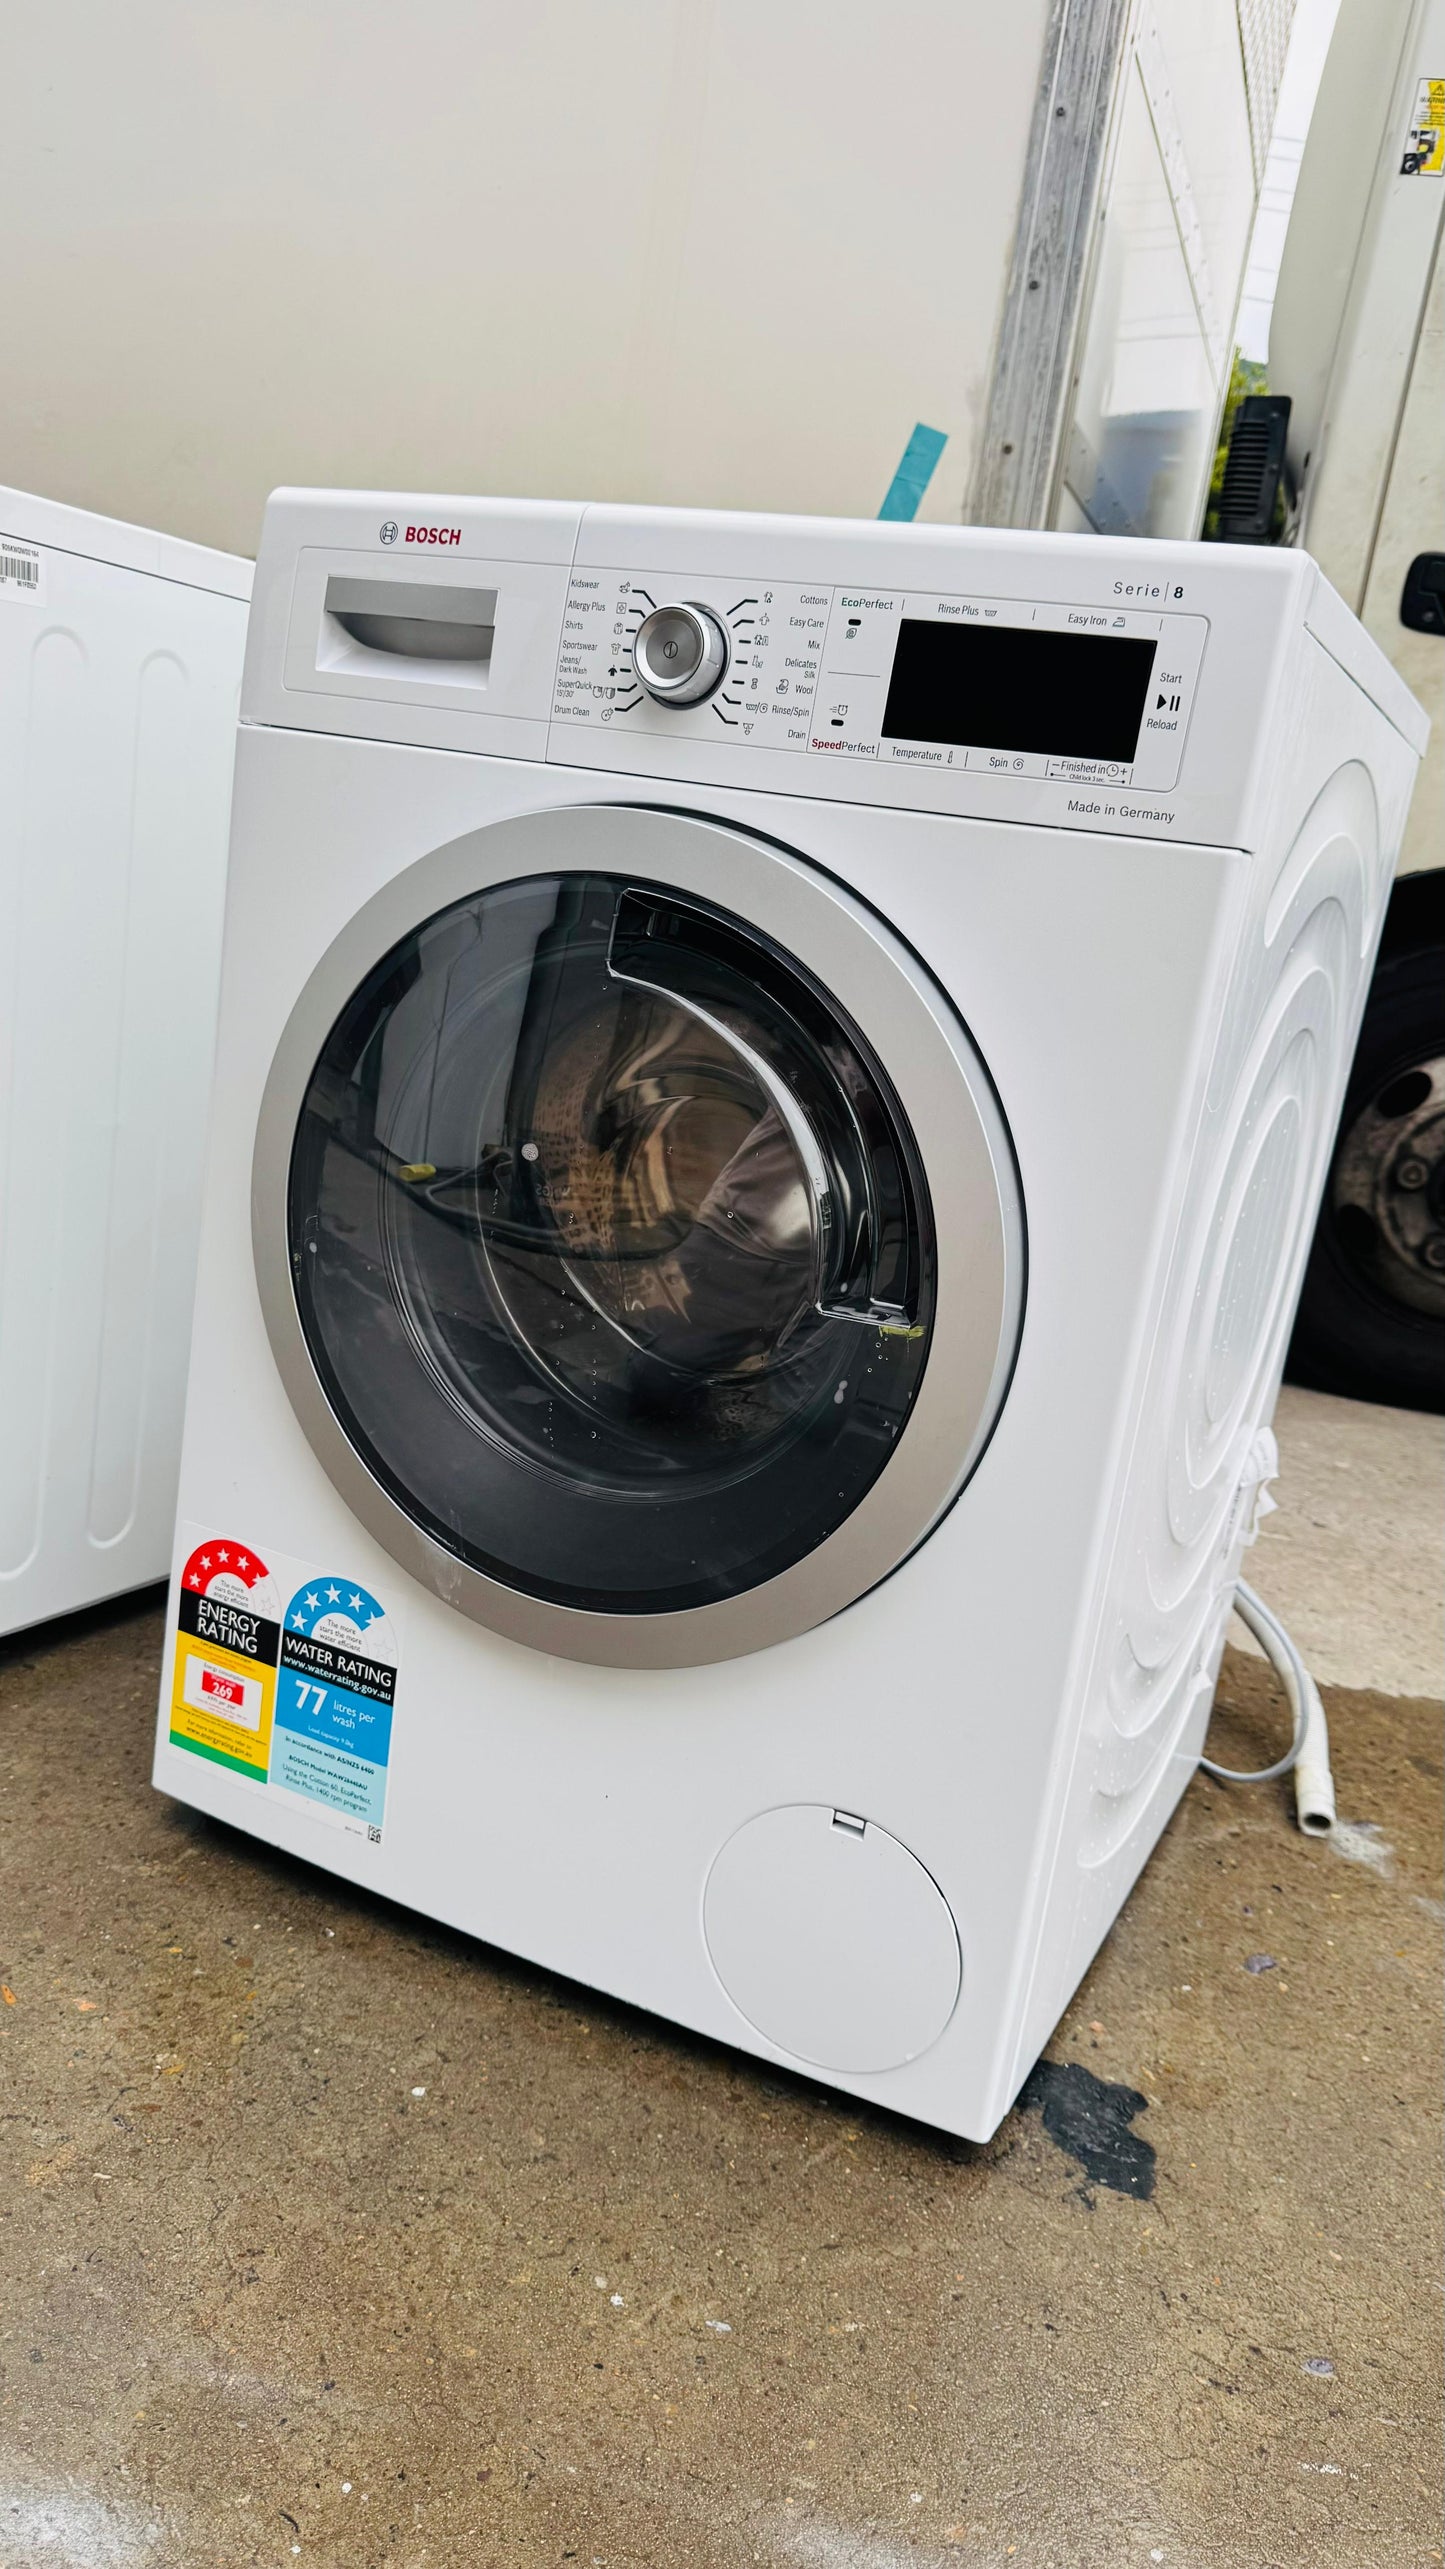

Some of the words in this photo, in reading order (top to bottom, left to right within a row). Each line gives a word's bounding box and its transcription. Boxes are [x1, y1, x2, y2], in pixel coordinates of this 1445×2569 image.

[405, 526, 462, 545] BOSCH
[571, 579, 600, 589] Kidswear
[1113, 581, 1160, 597] Serie
[1174, 586, 1184, 599] 8
[568, 600, 591, 612] Allergy
[591, 601, 606, 611] Plus
[800, 595, 828, 605] Cottons
[841, 597, 894, 610] EcoPerfect
[938, 603, 960, 614] Rinse
[961, 604, 979, 616] Plus
[565, 620, 584, 630] Shirts
[789, 616, 806, 628] Easy
[807, 618, 824, 628] Care
[1068, 613, 1089, 626] Easy
[1090, 615, 1107, 626] Iron
[562, 639, 598, 651] Sportswear
[808, 640, 820, 649] Mix
[560, 655, 582, 665] Jeans/
[785, 657, 817, 669] Delicates
[559, 665, 572, 673] Dark
[572, 665, 588, 675] Wash
[804, 670, 815, 679] Silk
[1160, 672, 1182, 683] Start
[557, 679, 593, 690] SuperQuick
[795, 684, 814, 694] Wool
[554, 705, 571, 714] Drum
[572, 706, 590, 716] Clean
[772, 704, 810, 717] Rinse/Spin
[1147, 718, 1177, 730] Reload
[788, 729, 806, 739] Drain
[811, 738, 875, 754] SpeedPerfect
[892, 746, 942, 761] Temperature
[989, 756, 1008, 768] Spin
[1060, 760, 1097, 774] Finished
[1097, 765, 1106, 774] in
[1067, 800, 1101, 814] Made
[1104, 803, 1115, 815] in
[1119, 806, 1175, 824] Germany
[198, 1598, 261, 1635] ENERGY
[328, 1618, 339, 1629] The
[340, 1624, 356, 1635] more
[197, 1616, 258, 1653] RATING
[320, 1625, 334, 1635] stars
[335, 1629, 345, 1639] the
[346, 1634, 362, 1646] more
[319, 1633, 337, 1644] water
[337, 1638, 361, 1653] efficient
[286, 1636, 334, 1667] WATER
[337, 1655, 392, 1687] RATING
[283, 1655, 392, 1701] www.waterrating.gov.au
[212, 1682, 233, 1700] 269
[295, 1679, 328, 1716] 77
[333, 1699, 357, 1717] litres
[358, 1711, 376, 1724] per
[332, 1714, 356, 1730] wash
[288, 1754, 310, 1768] BOSCH
